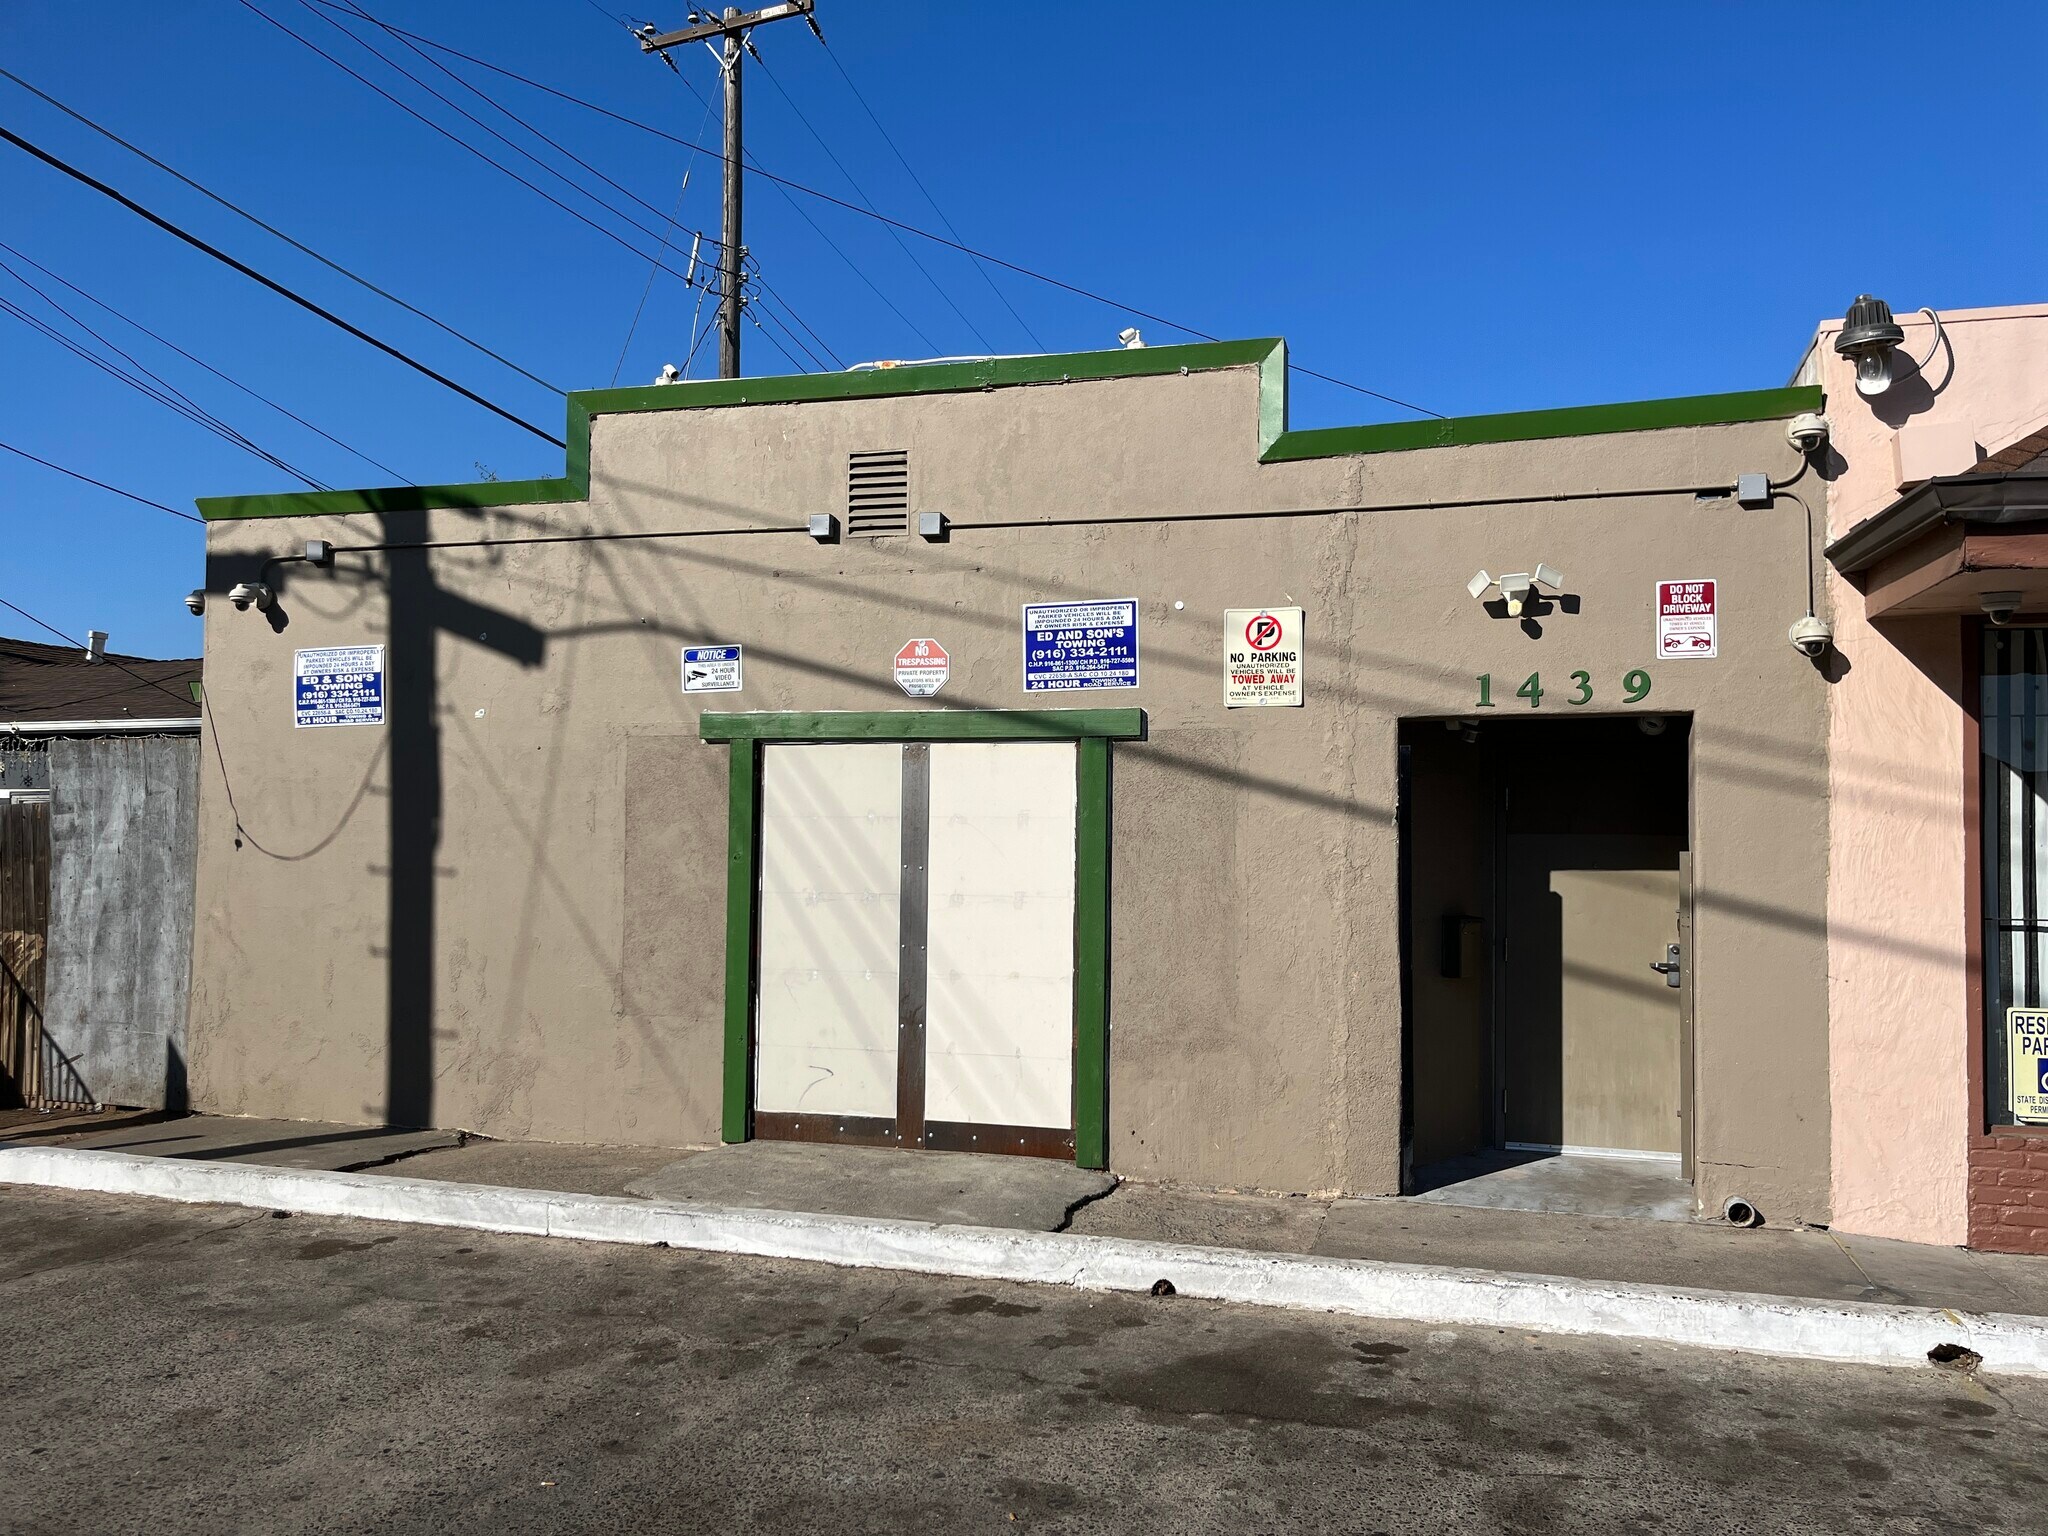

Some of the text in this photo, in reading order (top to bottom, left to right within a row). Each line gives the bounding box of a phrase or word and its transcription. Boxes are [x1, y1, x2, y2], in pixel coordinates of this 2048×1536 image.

[1669, 584, 1704, 594] DO NOT
[1671, 594, 1703, 604] BLOCK
[1029, 607, 1078, 615] UNAUTHORIZED
[1663, 603, 1712, 614] DRIVEWAY
[1037, 628, 1124, 641] ED AND SON'S
[1055, 639, 1106, 649] TOWING
[697, 649, 727, 660] NOTICE
[915, 645, 929, 656] NO
[1032, 646, 1127, 661] (916) 334-2111
[898, 657, 946, 666] TRESPASSING
[1230, 652, 1297, 663] NO PARKING
[302, 673, 375, 685] ED & SON'S
[1232, 674, 1296, 684] TOWED AWAY
[313, 682, 364, 691] TOWING
[1031, 680, 1081, 689] 24 HOUR
[302, 689, 375, 699] (916) 334-2111
[2015, 1015, 2048, 1035] RES
[2016, 1095, 2036, 1104] STATE
